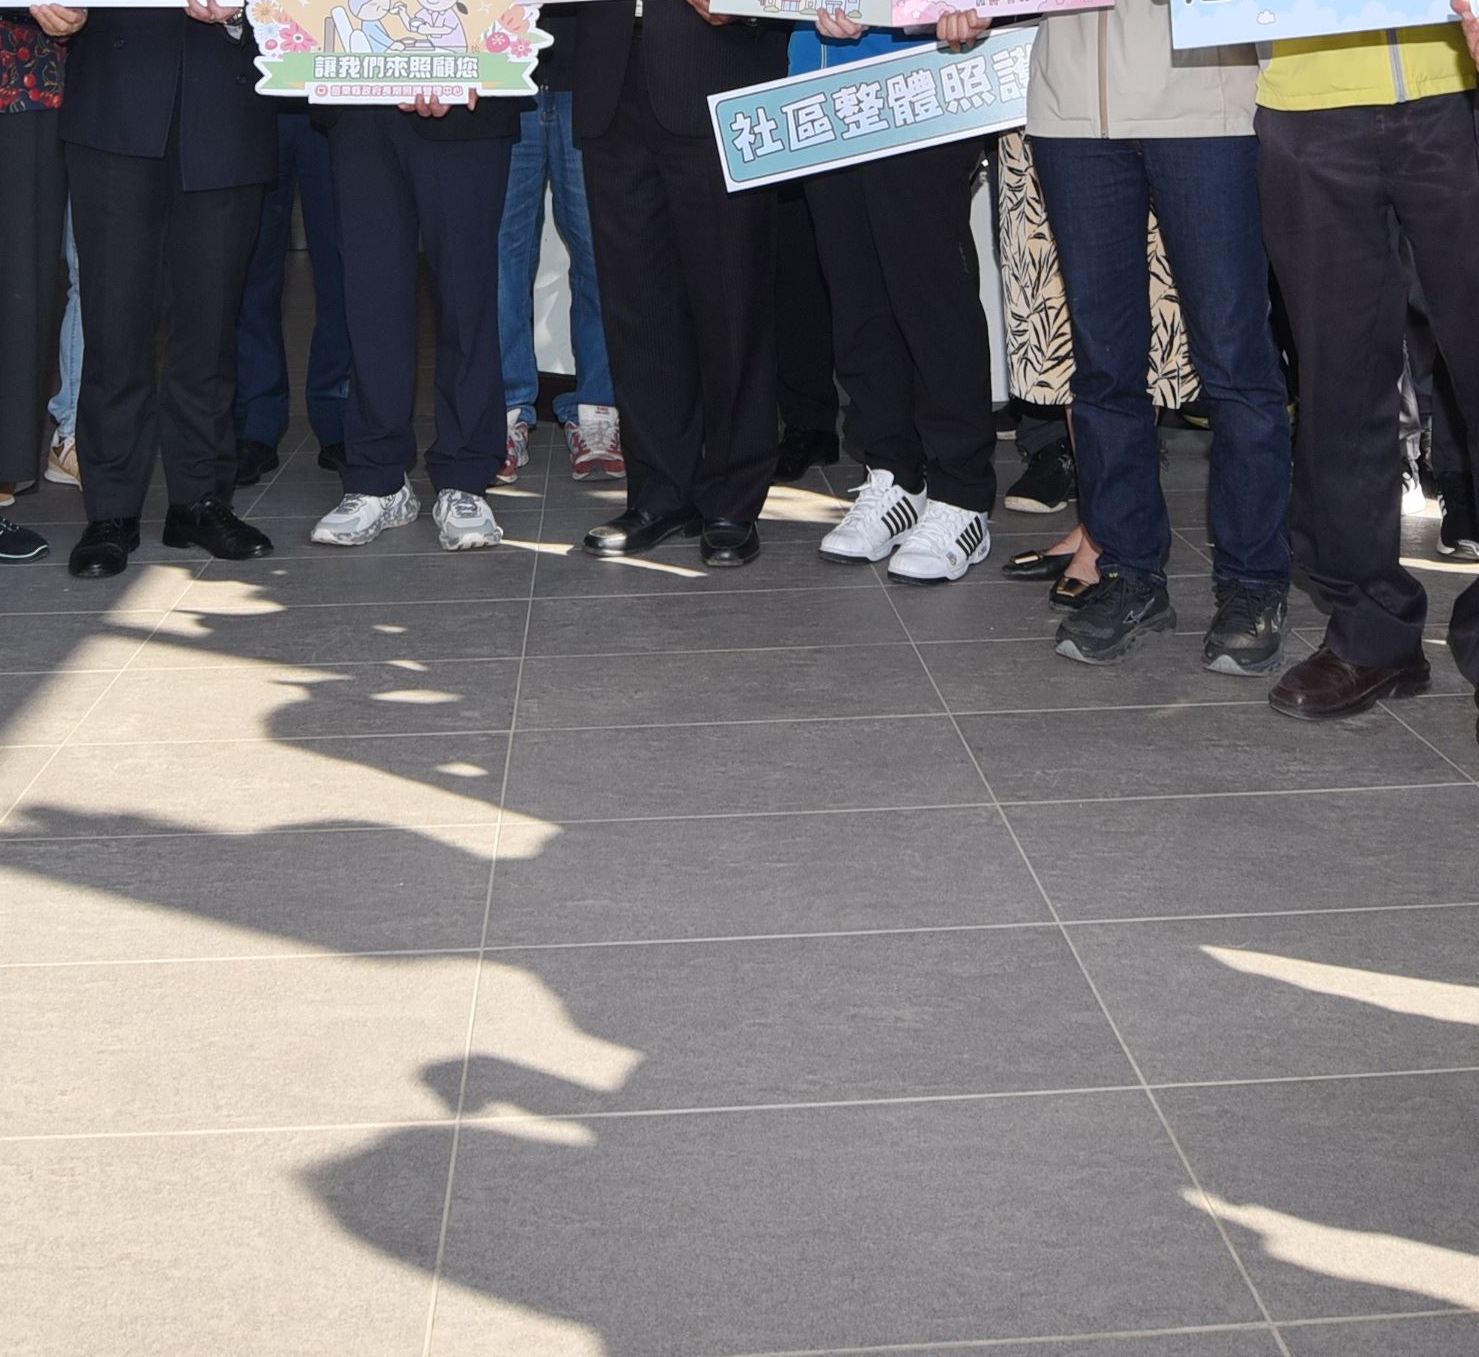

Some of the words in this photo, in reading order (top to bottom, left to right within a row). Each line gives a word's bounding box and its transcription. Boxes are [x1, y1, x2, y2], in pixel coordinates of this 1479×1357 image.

[313, 55, 480, 79] 讓我們來照顧您
